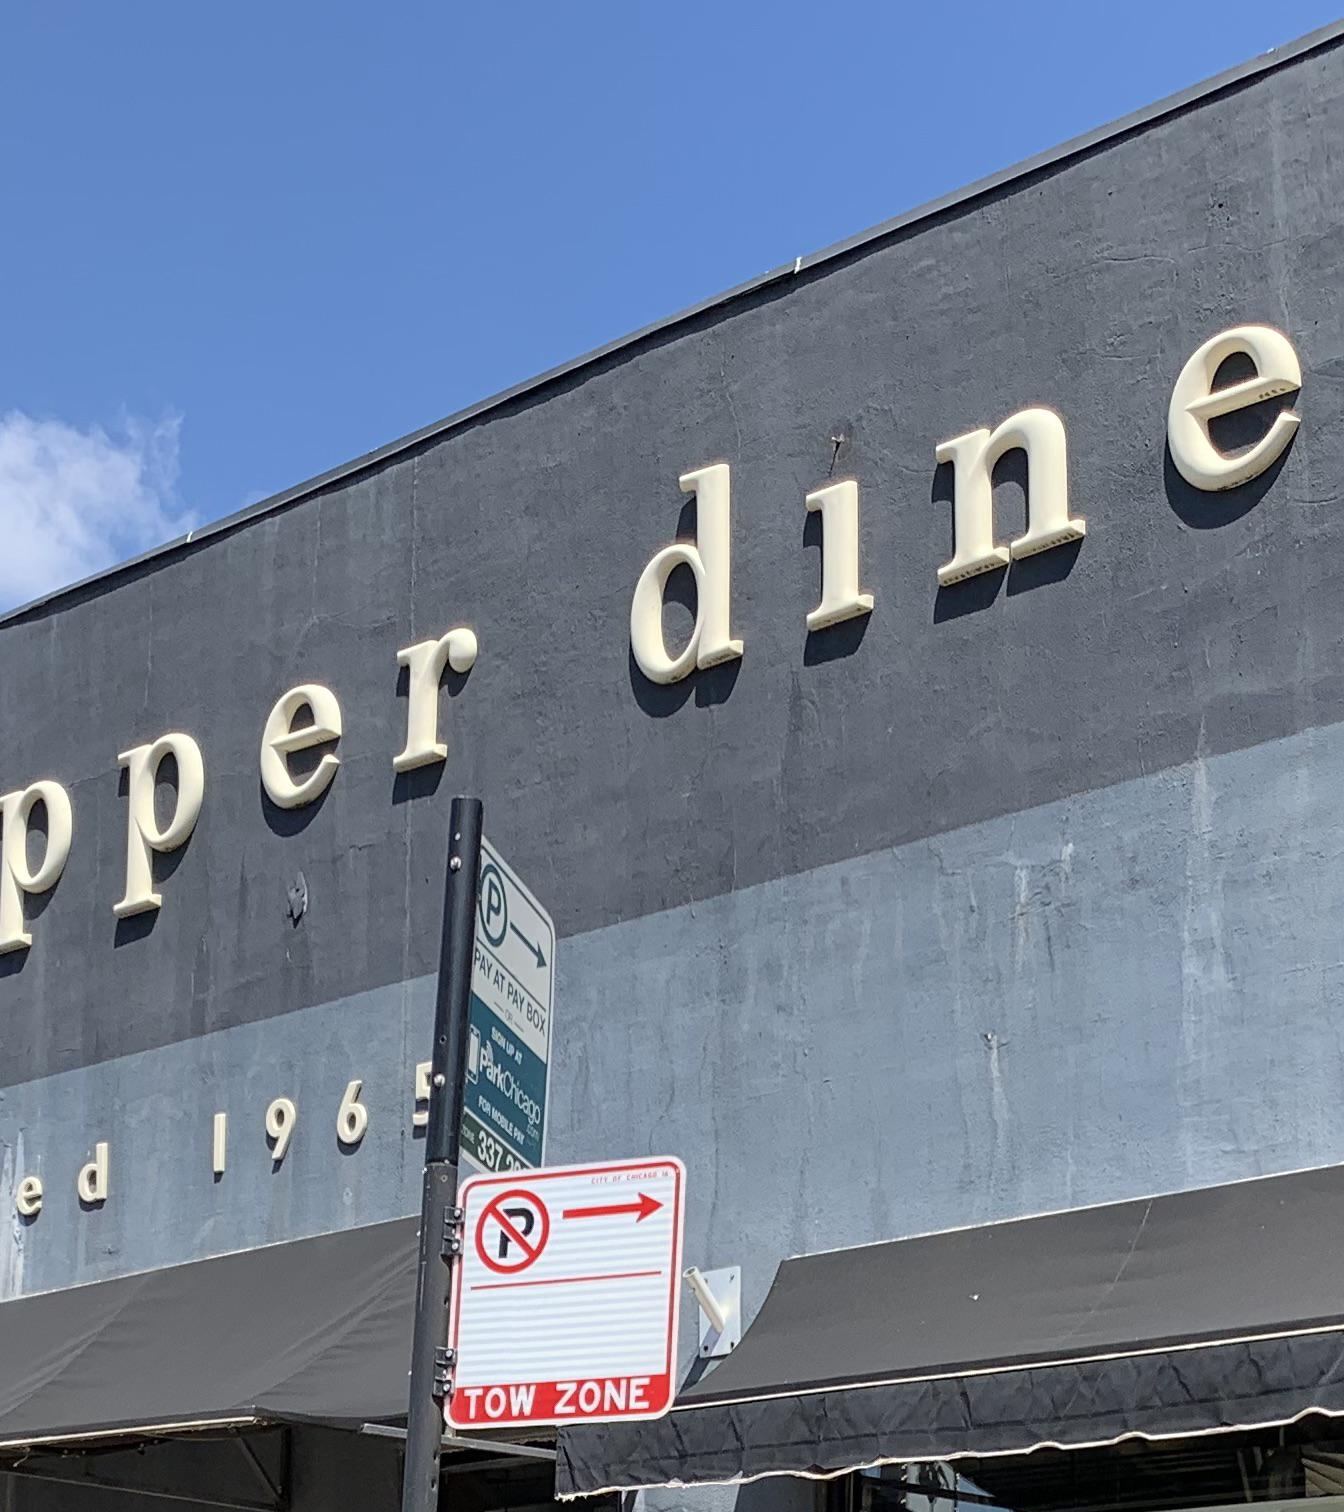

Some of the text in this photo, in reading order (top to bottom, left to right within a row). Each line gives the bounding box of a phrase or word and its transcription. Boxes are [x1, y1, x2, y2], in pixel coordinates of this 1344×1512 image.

[474, 947, 546, 1036] PAY AT PAY BOX
[477, 1129, 504, 1173] 337
[463, 1377, 651, 1420] TOW ZONE
